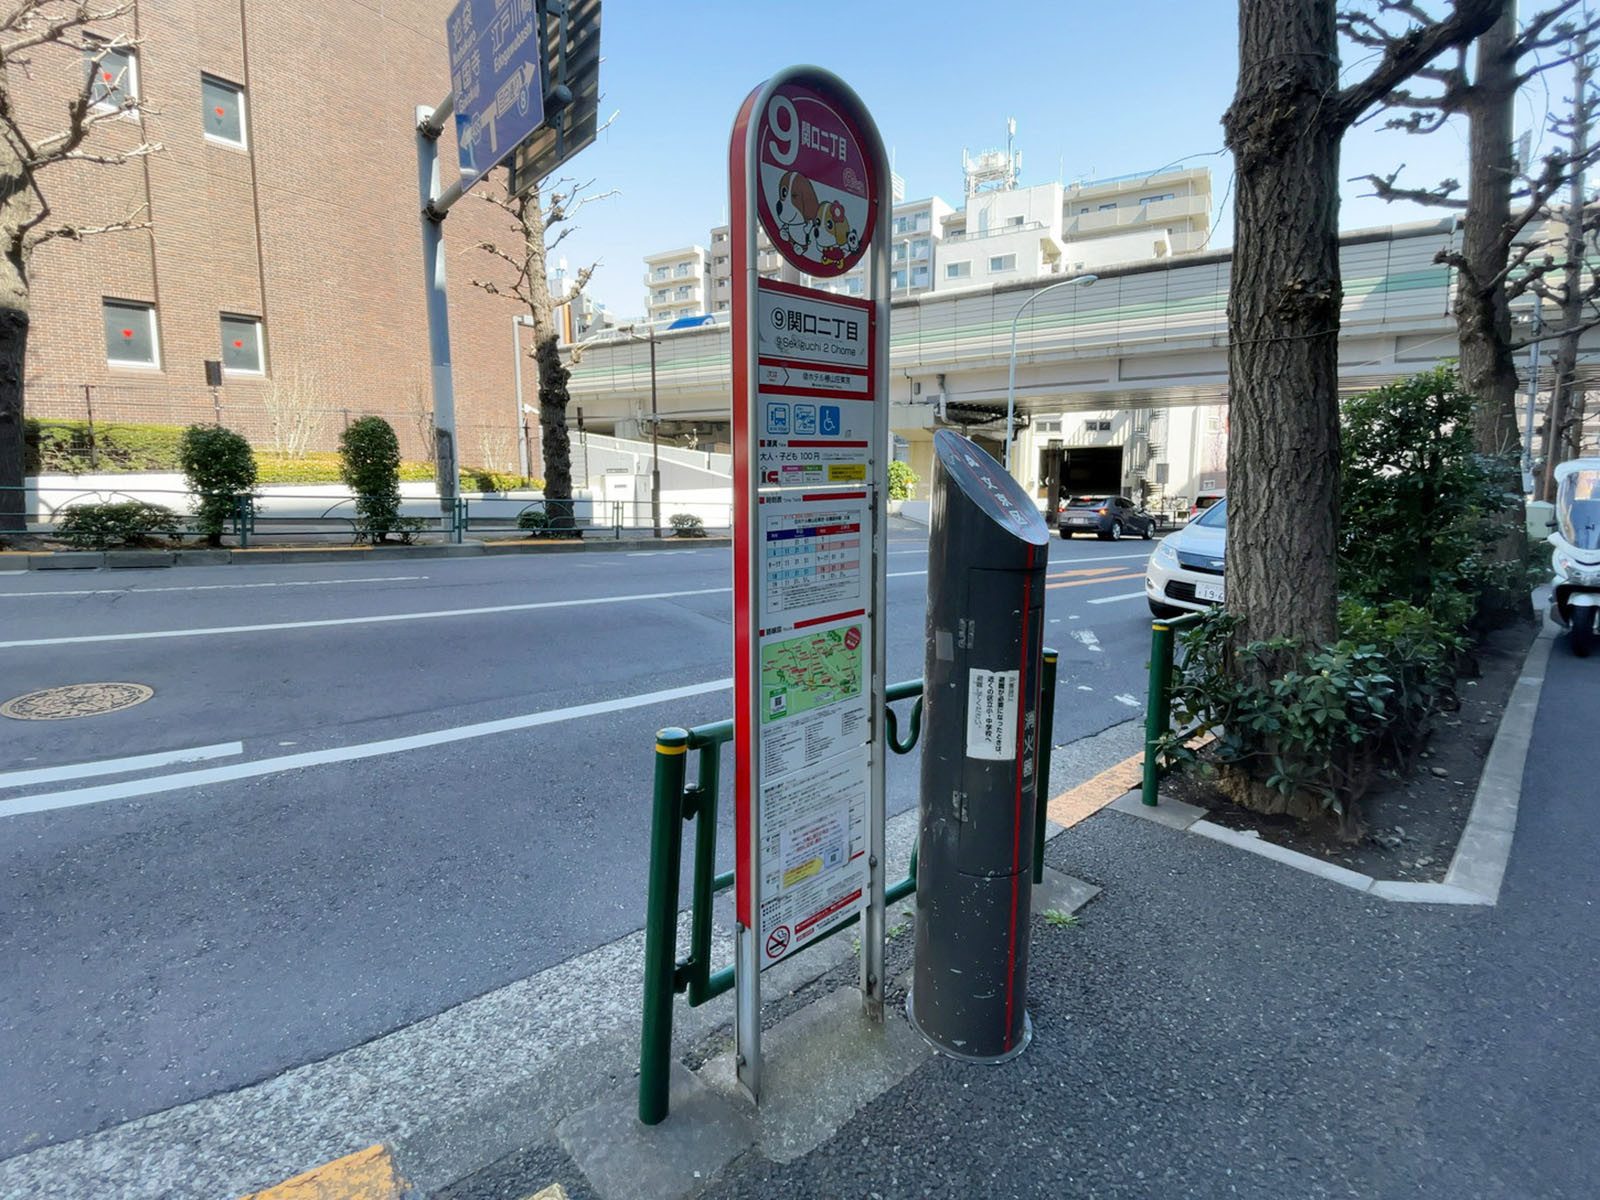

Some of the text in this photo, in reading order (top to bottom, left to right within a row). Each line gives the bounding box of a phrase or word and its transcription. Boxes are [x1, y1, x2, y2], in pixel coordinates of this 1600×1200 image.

[768, 95, 800, 166] 9
[802, 121, 847, 162] 関口二丁目
[823, 343, 829, 353] 2
[800, 452, 820, 461] 100円
[1023, 710, 1035, 778] 消火器
